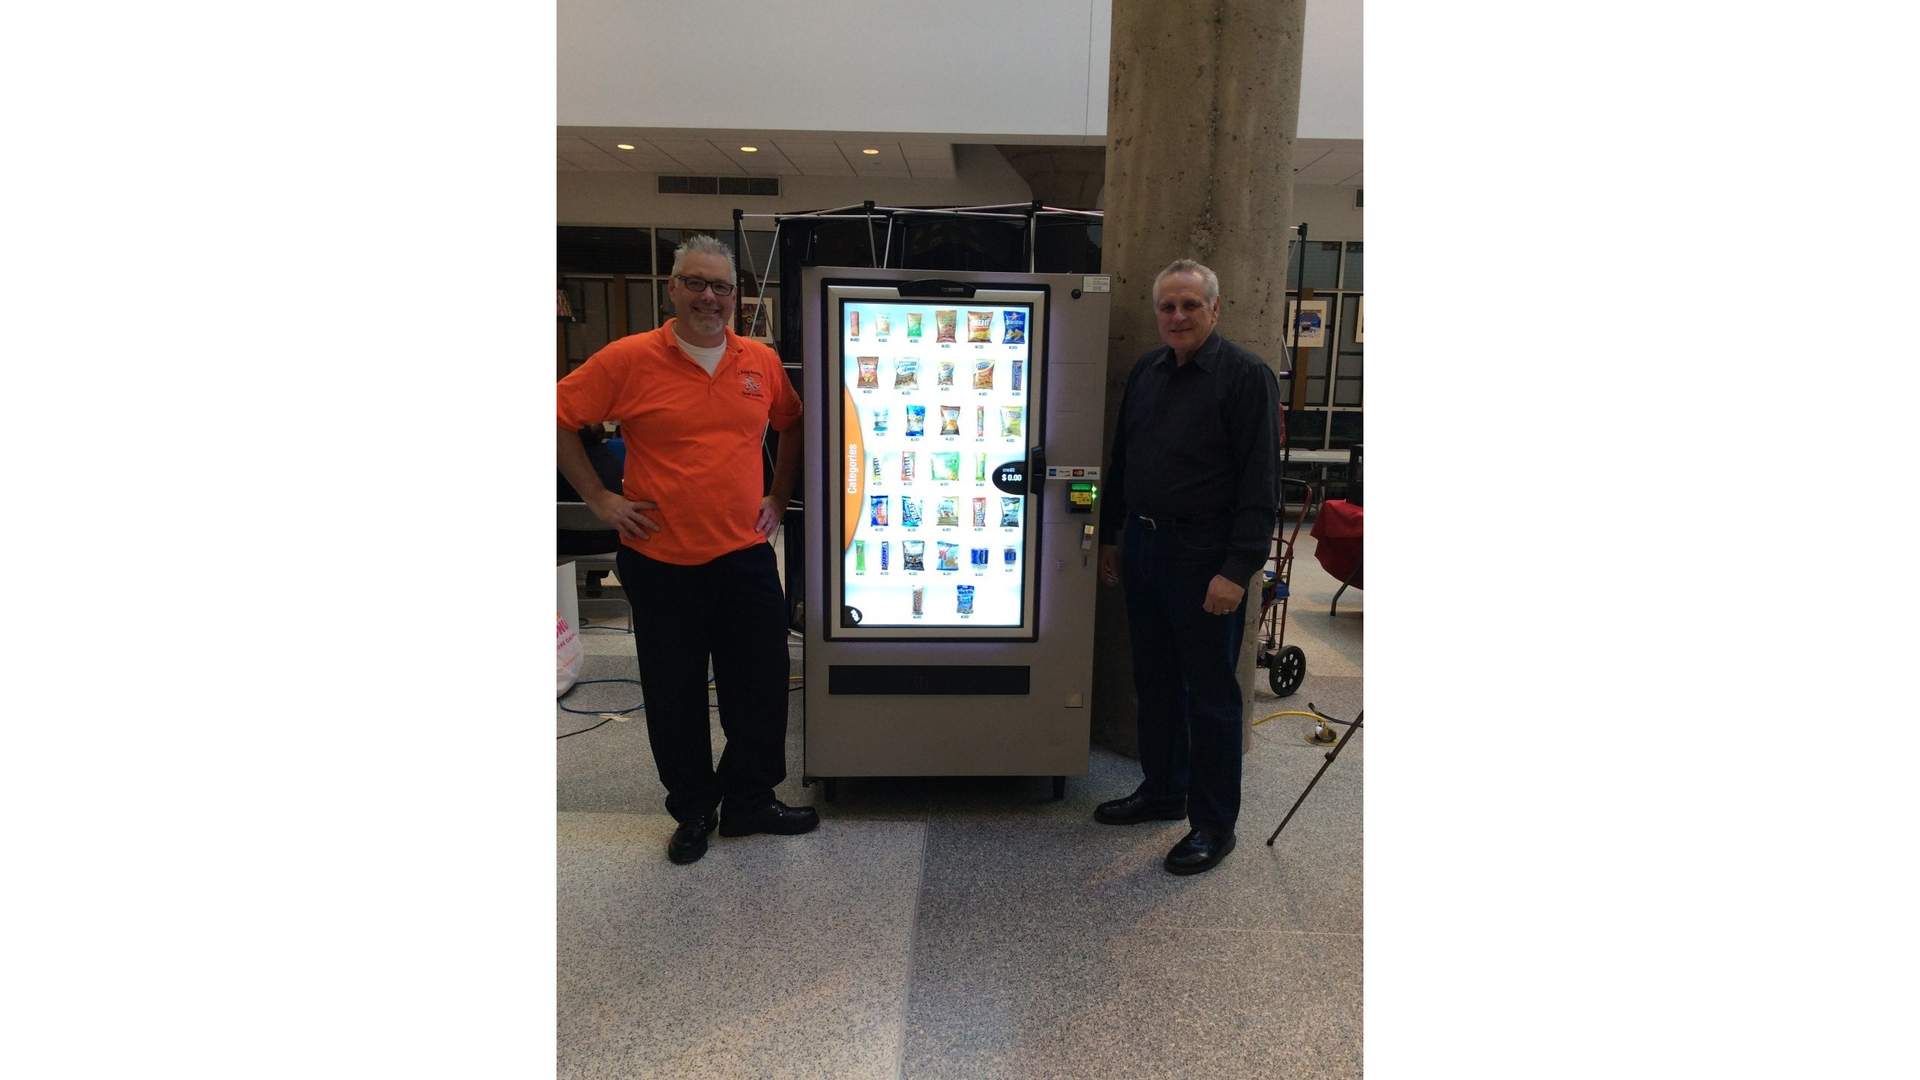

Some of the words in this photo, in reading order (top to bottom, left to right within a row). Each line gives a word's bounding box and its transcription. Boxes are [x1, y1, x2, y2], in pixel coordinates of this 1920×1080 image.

[847, 444, 859, 494] Categories
[1001, 474, 1007, 482] $
[1007, 474, 1022, 482] 0.00
